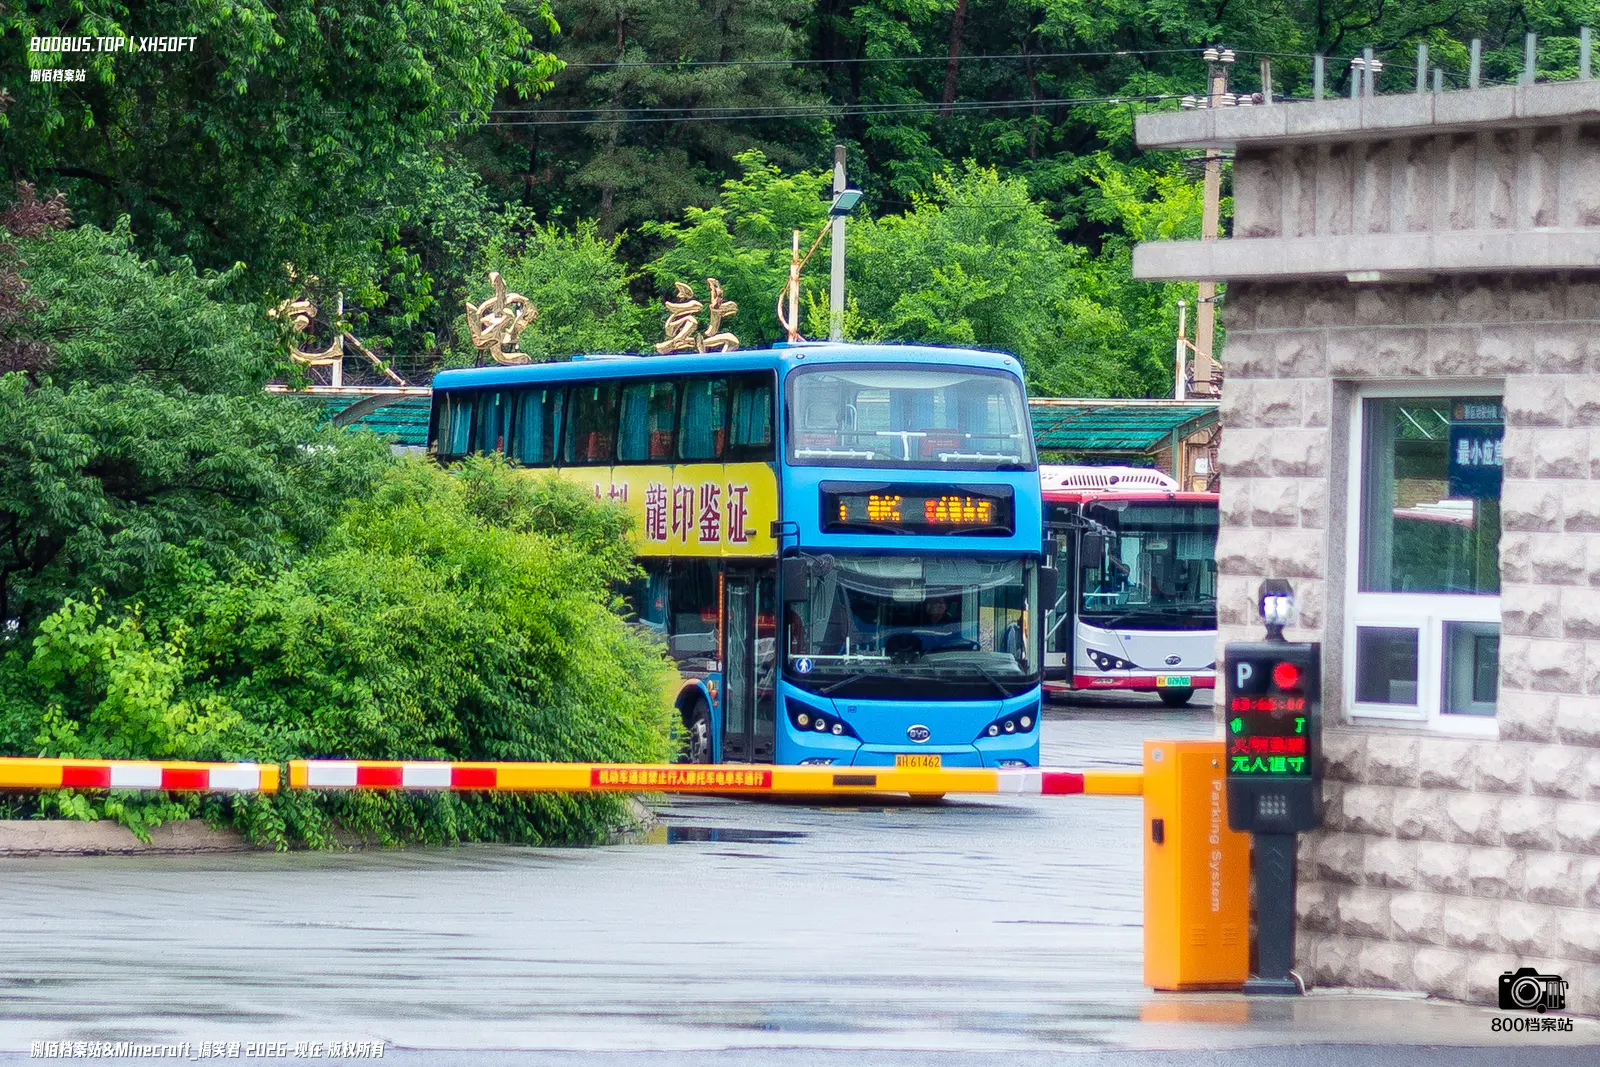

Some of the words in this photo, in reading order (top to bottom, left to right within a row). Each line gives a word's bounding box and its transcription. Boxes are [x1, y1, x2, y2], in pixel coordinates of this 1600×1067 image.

[644, 481, 750, 545] 龍印鉴证
[1236, 661, 1253, 689] P
[1209, 780, 1222, 845] Parking
[1209, 850, 1222, 913] System
